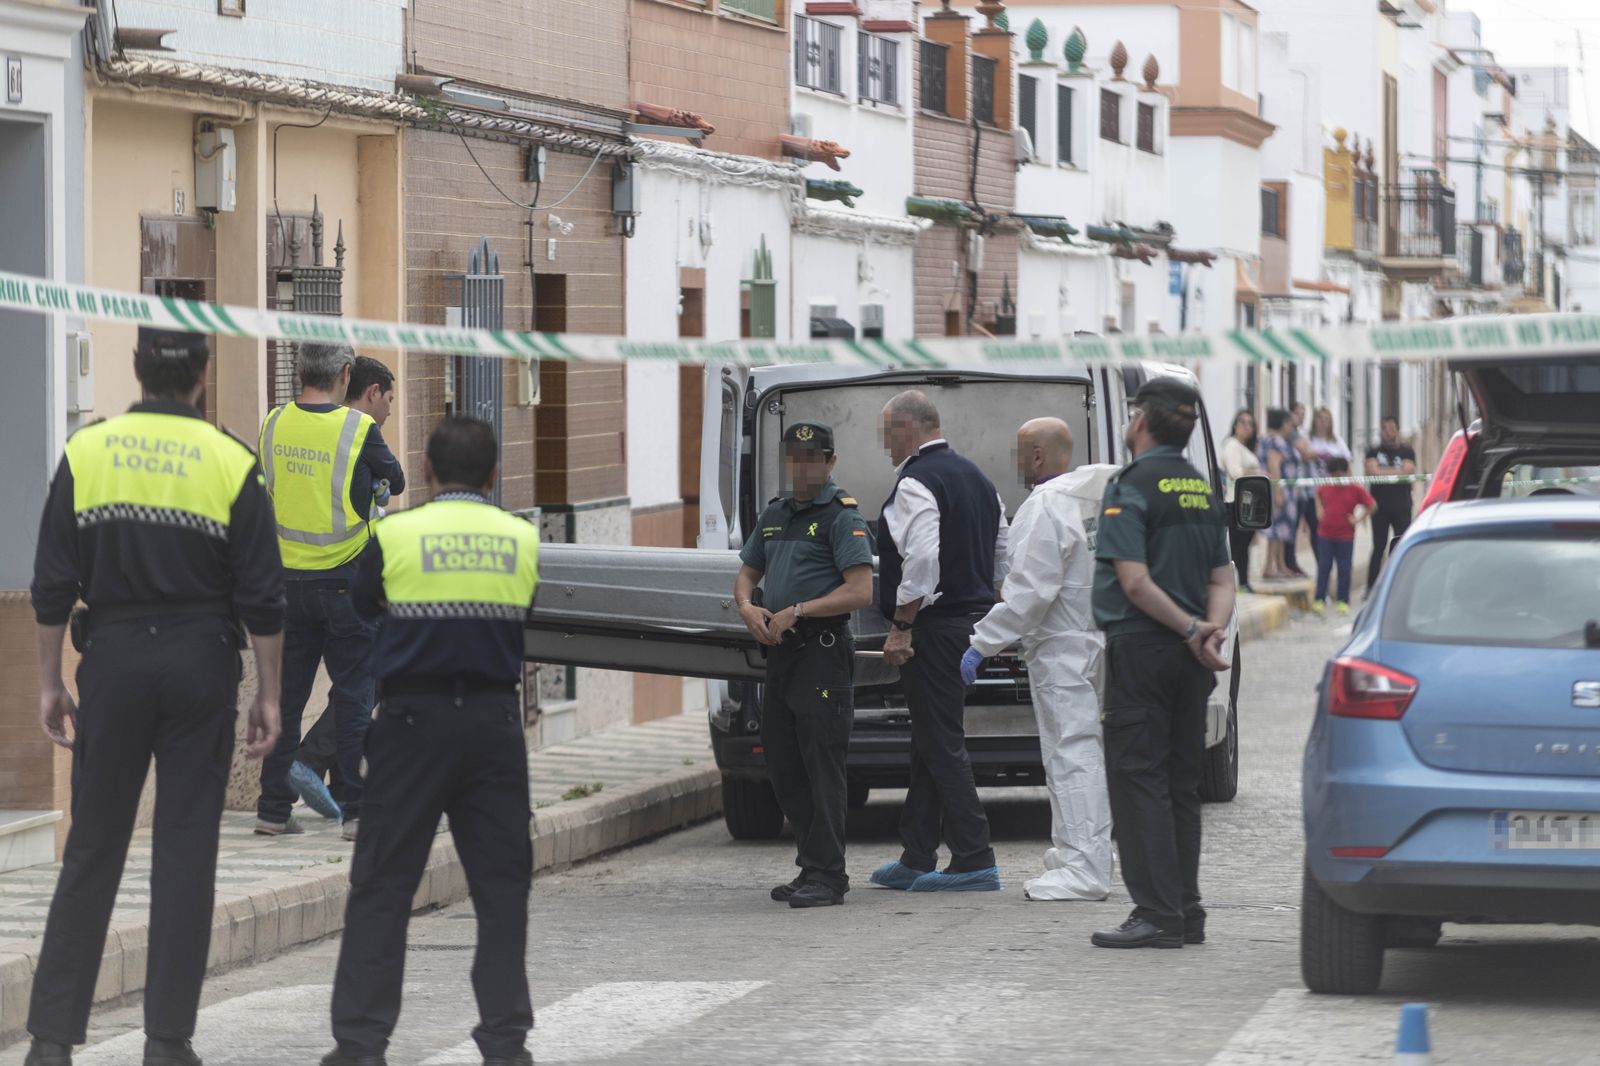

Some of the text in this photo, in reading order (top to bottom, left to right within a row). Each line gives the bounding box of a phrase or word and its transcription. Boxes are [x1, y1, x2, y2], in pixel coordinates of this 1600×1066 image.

[35, 284, 71, 310] CIVIL
[76, 289, 98, 314] NO
[101, 294, 153, 320] PASAR
[105, 433, 203, 462] POLICIA
[273, 443, 332, 465] GUARDIA
[113, 452, 189, 478] LOCAL
[286, 461, 315, 476] CIVIL
[424, 533, 516, 556] POLICIA
[432, 551, 508, 571] LOCAL
